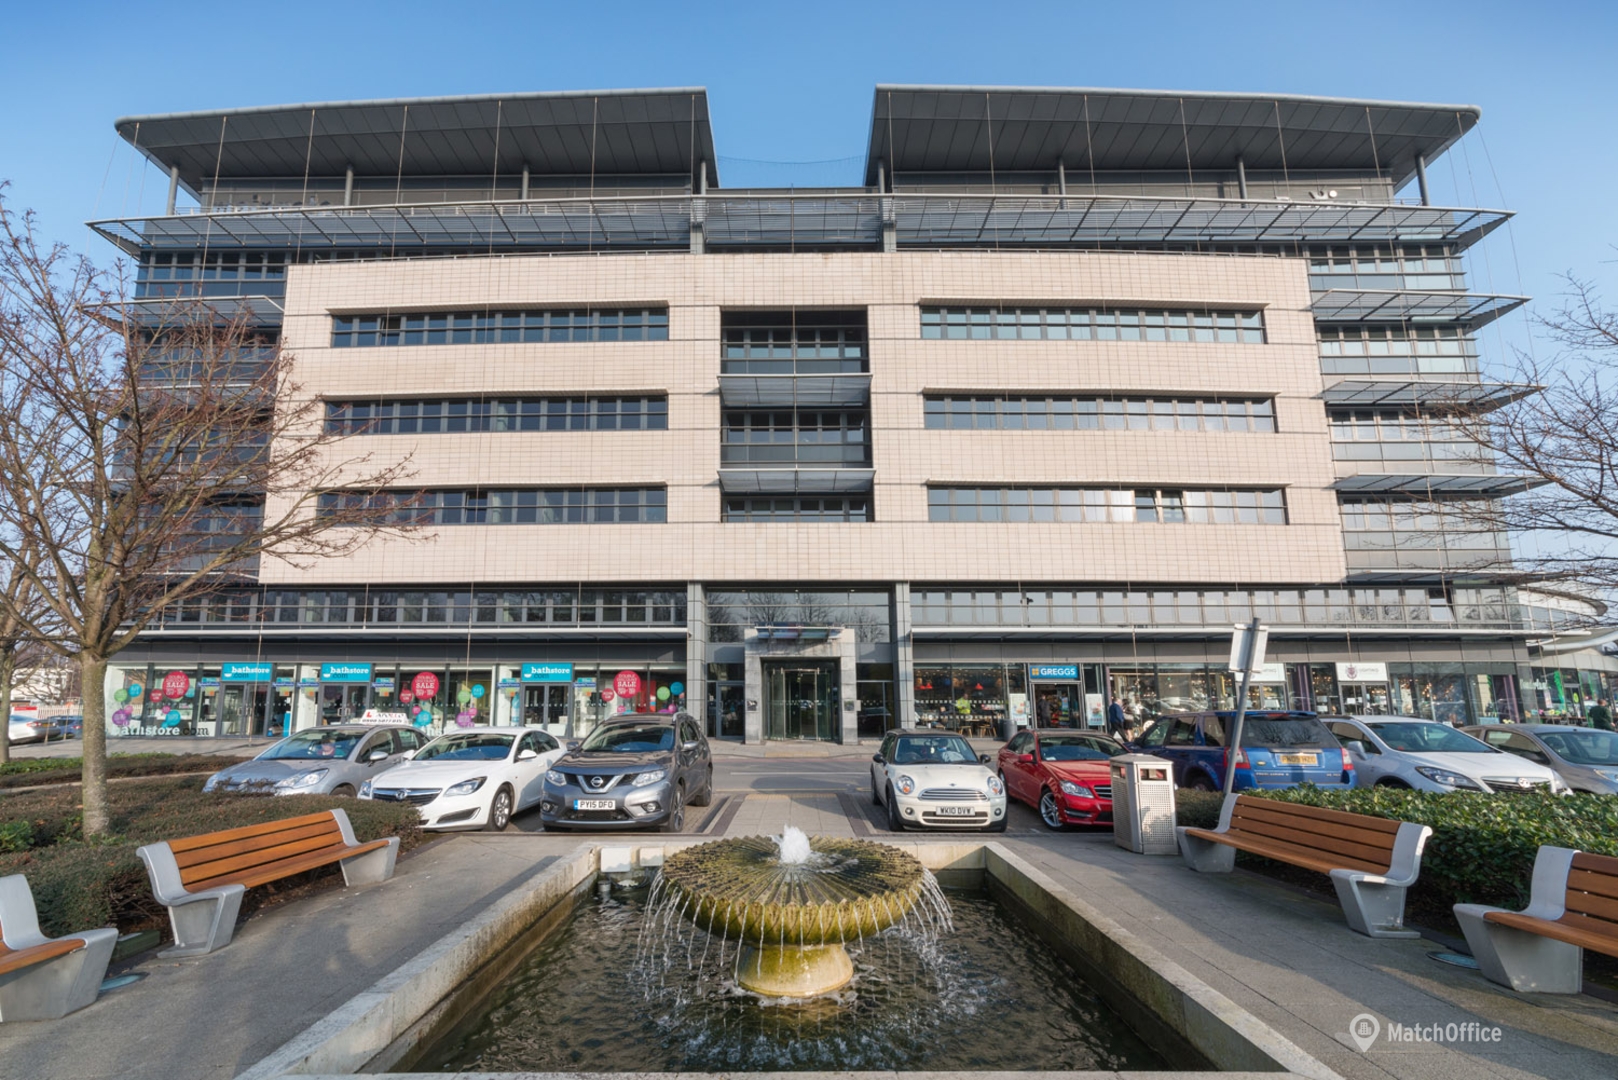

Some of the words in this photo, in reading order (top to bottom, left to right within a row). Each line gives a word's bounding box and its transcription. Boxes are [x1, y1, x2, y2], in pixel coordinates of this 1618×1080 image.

[231, 665, 270, 674] bathstore
[330, 666, 369, 675] bathstore
[531, 666, 571, 674] bathstore
[1040, 668, 1076, 676] GREGGS
[940, 806, 956, 814] WK10
[957, 806, 971, 814] DVW
